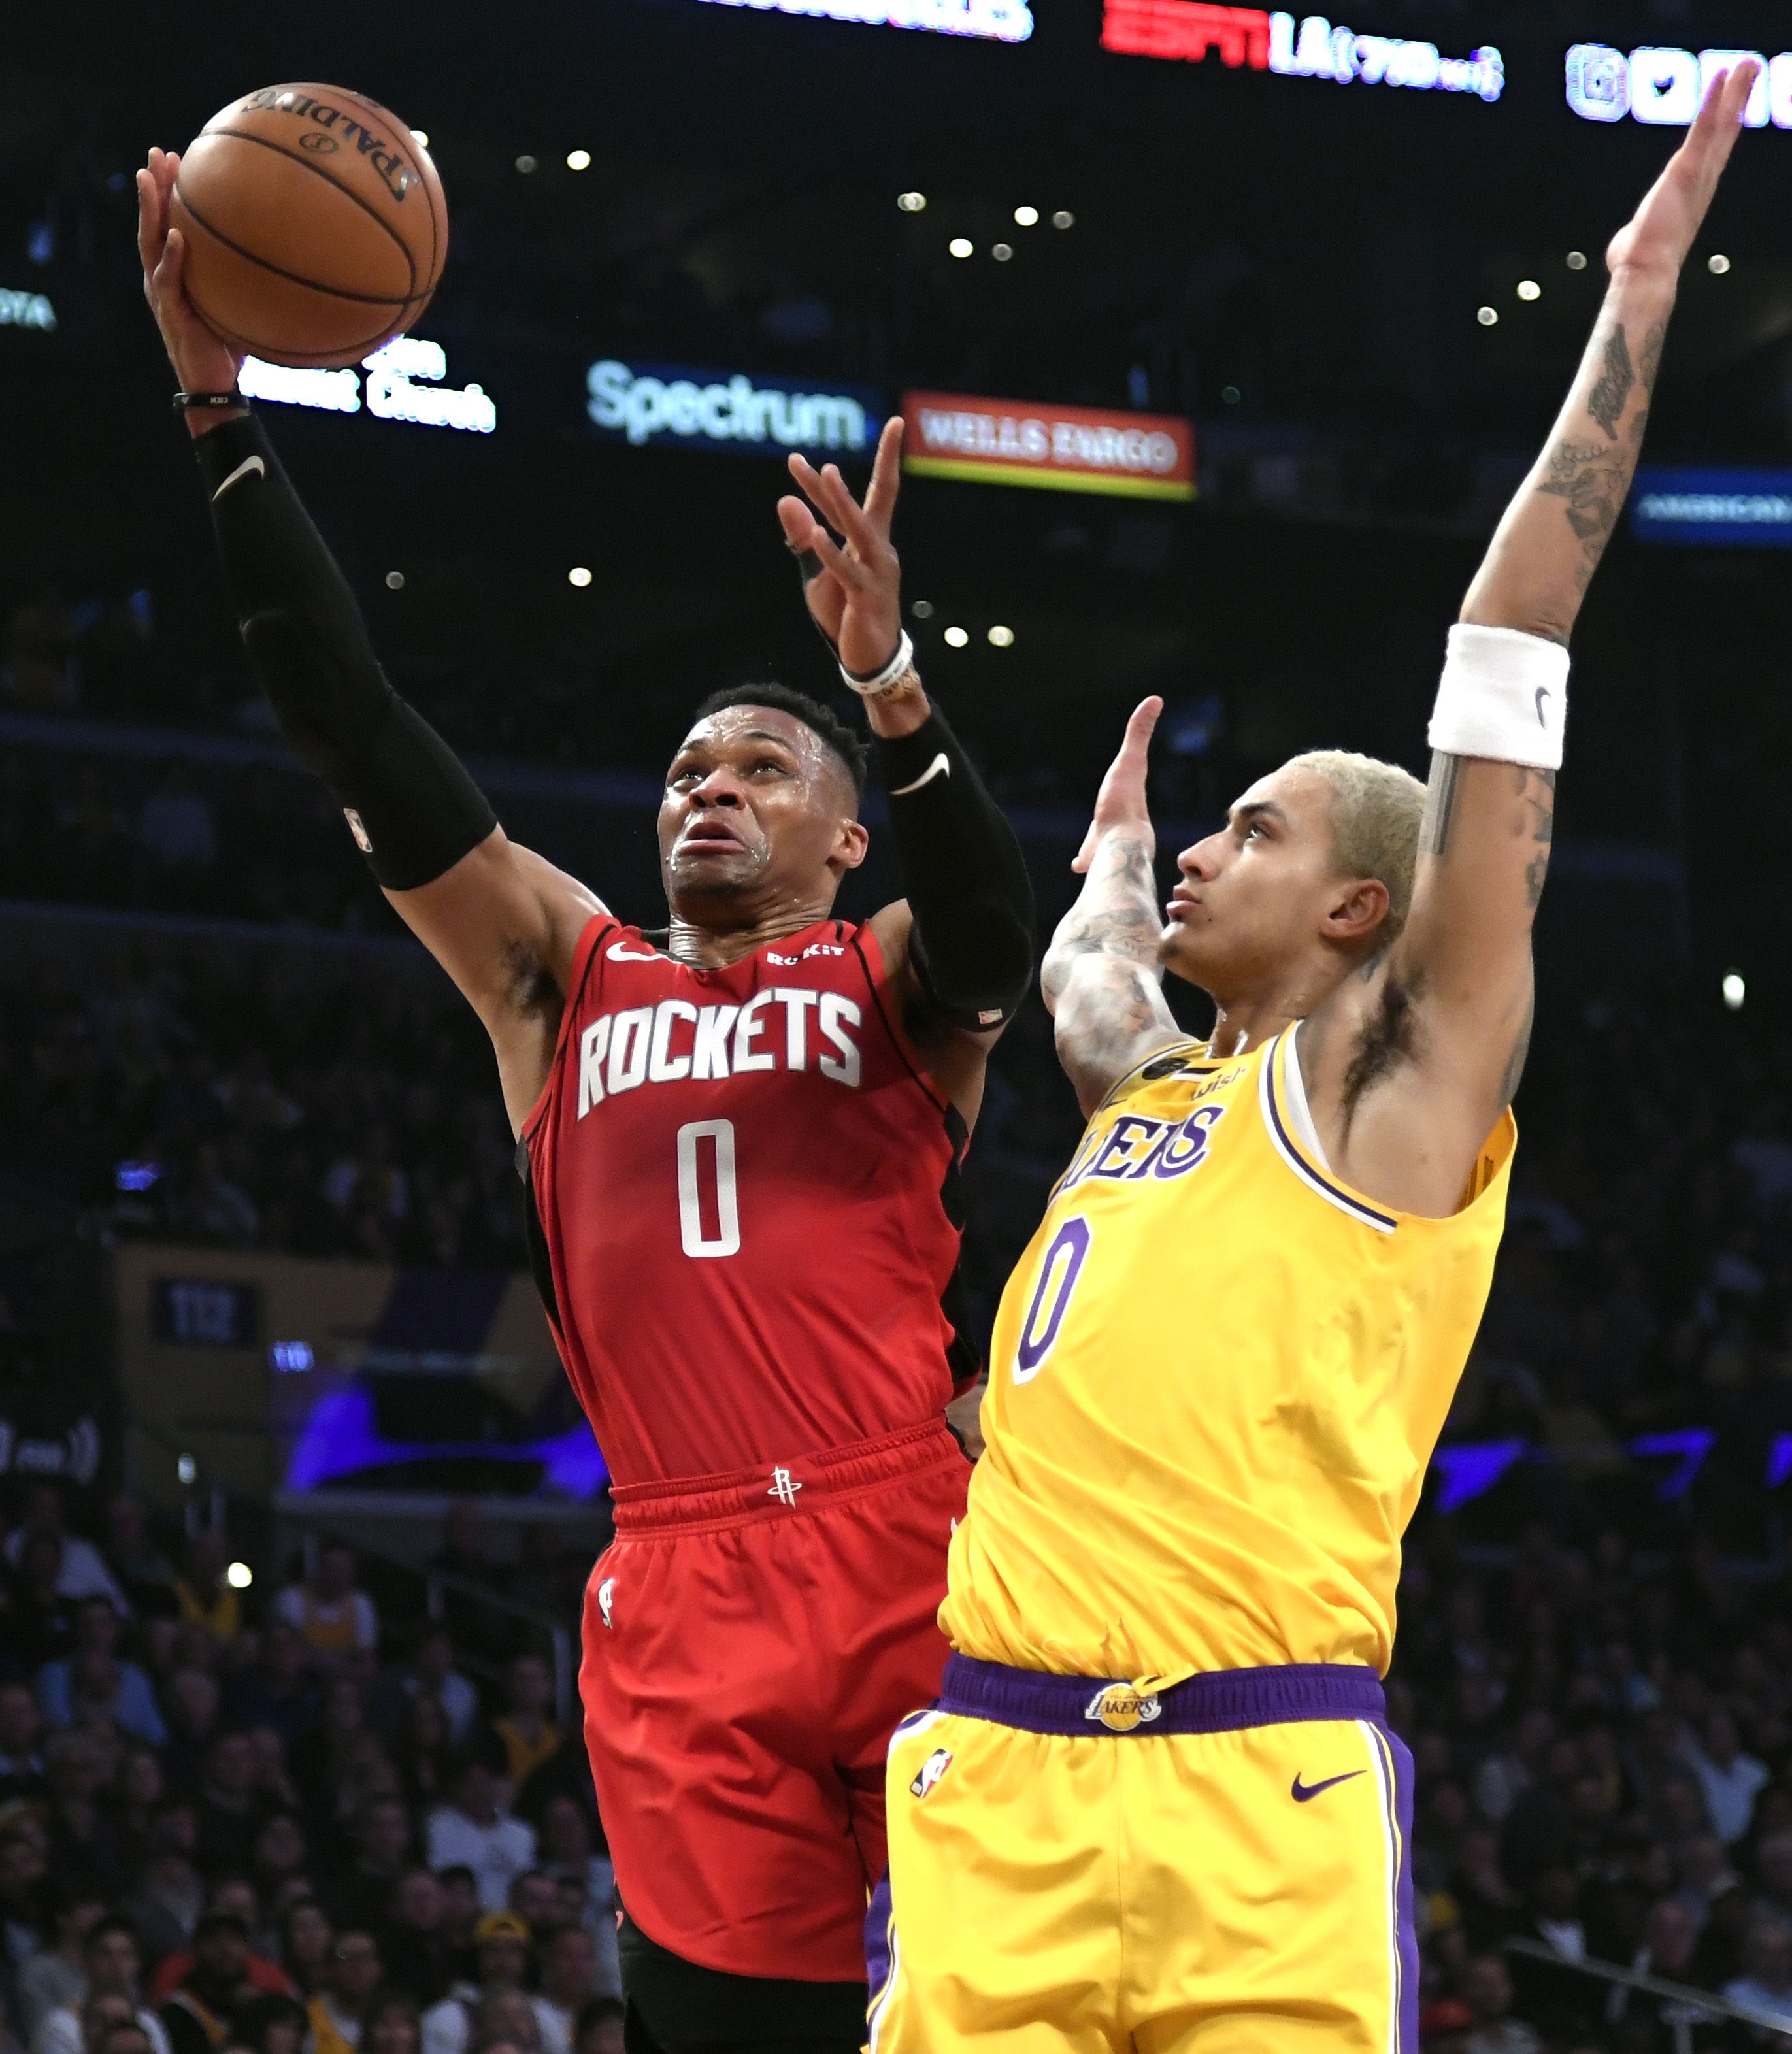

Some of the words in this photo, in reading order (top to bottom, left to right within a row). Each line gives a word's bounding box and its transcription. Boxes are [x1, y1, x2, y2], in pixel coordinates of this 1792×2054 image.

[241, 91, 411, 201] SPALDING
[588, 359, 866, 451] Spectrum
[919, 408, 1049, 461] WELLS
[1051, 422, 1177, 474] FARGO
[578, 987, 861, 1122] ROCKETS
[676, 1118, 740, 1258] 0
[1013, 1214, 1092, 1385] 0
